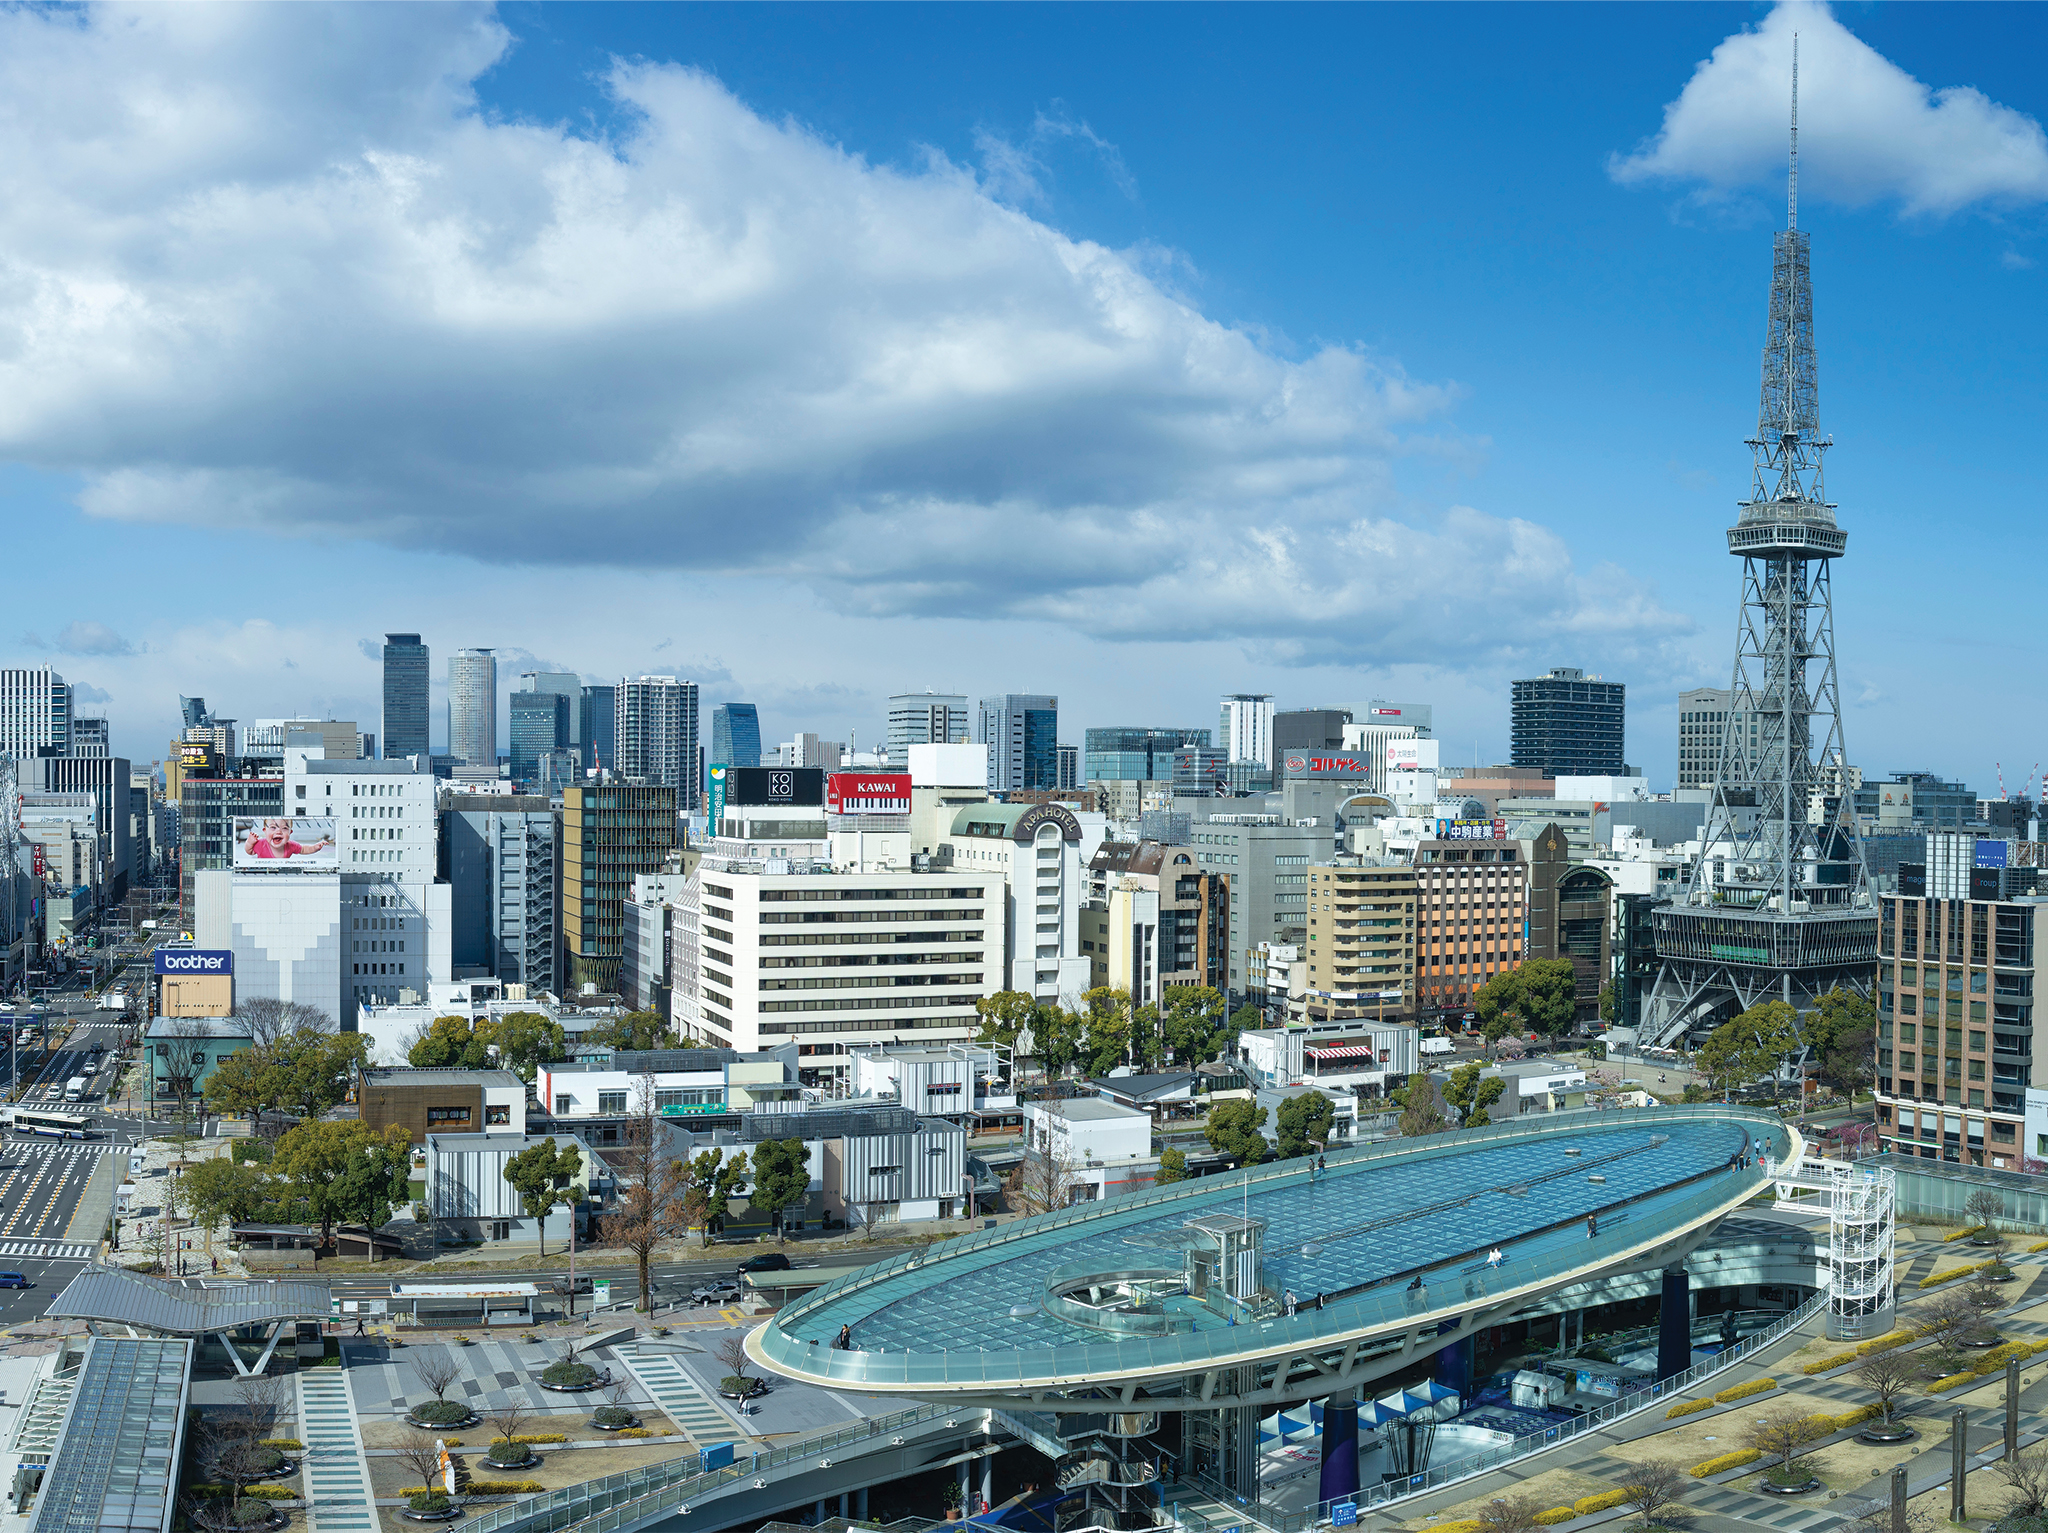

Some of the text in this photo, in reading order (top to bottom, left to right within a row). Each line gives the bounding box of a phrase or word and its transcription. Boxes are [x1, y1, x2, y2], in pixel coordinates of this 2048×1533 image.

[1396, 749, 1417, 758] 太陽生命
[772, 773, 790, 784] KO
[772, 784, 790, 795] KO
[857, 782, 896, 793] KAWAI
[1023, 806, 1078, 832] APA HOTEL
[1451, 825, 1493, 838] 中駒産業
[1974, 878, 1998, 889] Group
[165, 954, 224, 969] brother
